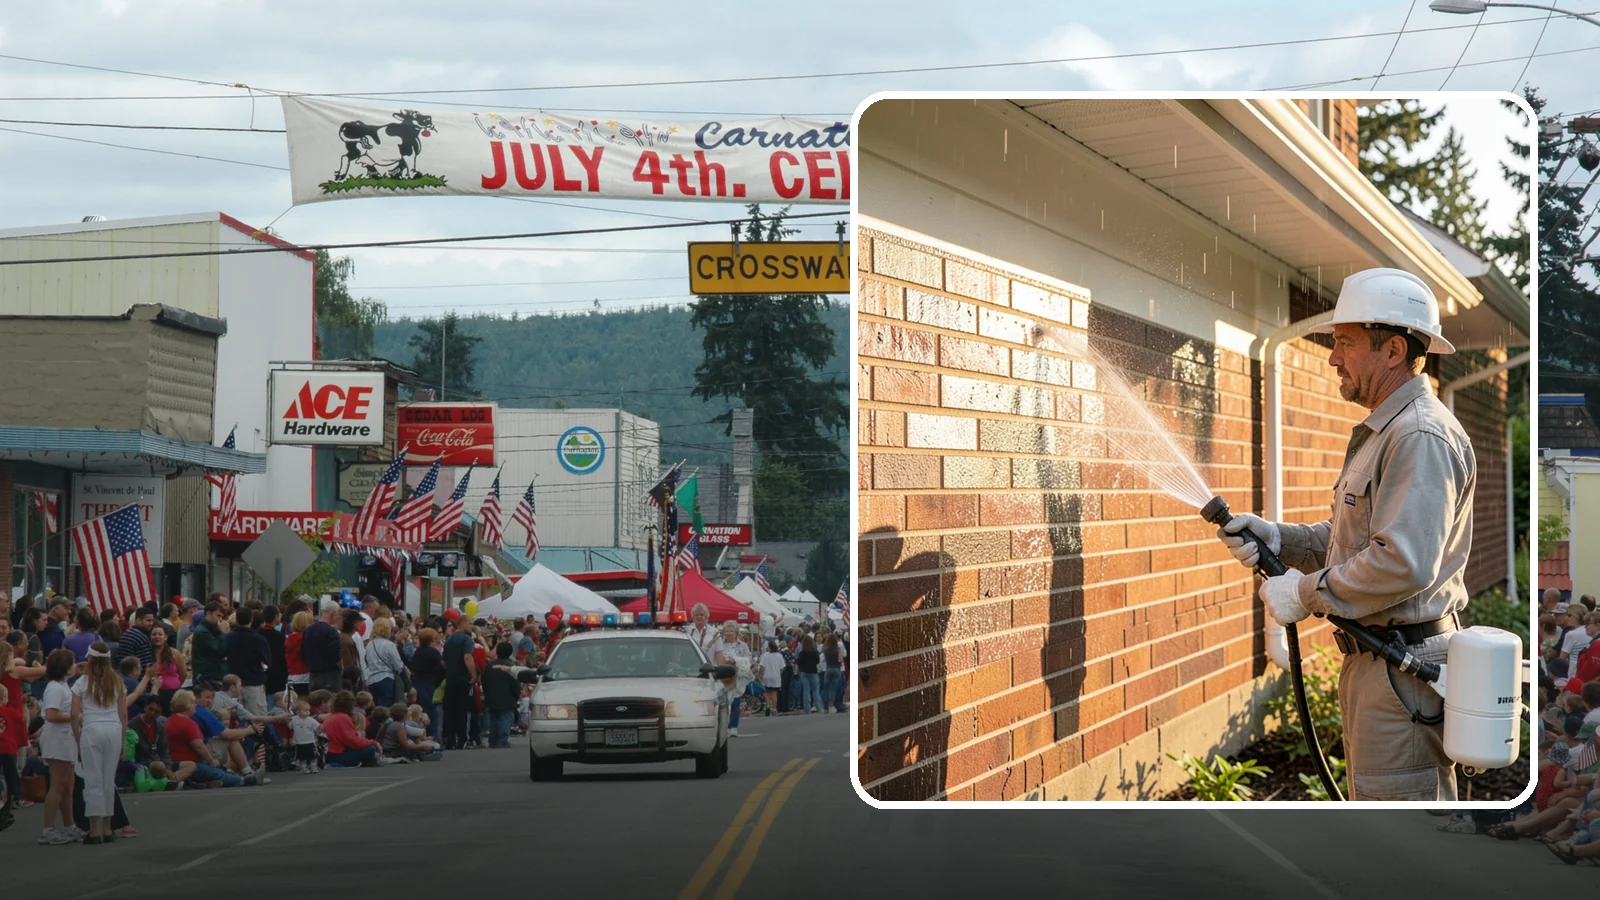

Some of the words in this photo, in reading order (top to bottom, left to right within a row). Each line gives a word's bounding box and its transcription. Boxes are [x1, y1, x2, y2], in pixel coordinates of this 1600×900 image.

[481, 141, 605, 192] JULY
[632, 150, 746, 198] 4th.
[697, 254, 850, 280] CROSSWA
[282, 380, 373, 420] ACE
[406, 409, 452, 422] CEDAR
[461, 409, 485, 422] LOG
[283, 421, 370, 436] Hardware
[416, 428, 477, 447] Coca-Cola
[83, 485, 93, 494] St.
[95, 485, 124, 494] Vincent
[126, 486, 136, 494] de
[137, 486, 155, 495] Paul
[81, 503, 153, 521] THT
[212, 516, 331, 536] HARDARE
[688, 527, 741, 535] CRNATION
[699, 535, 730, 543] GLASS
